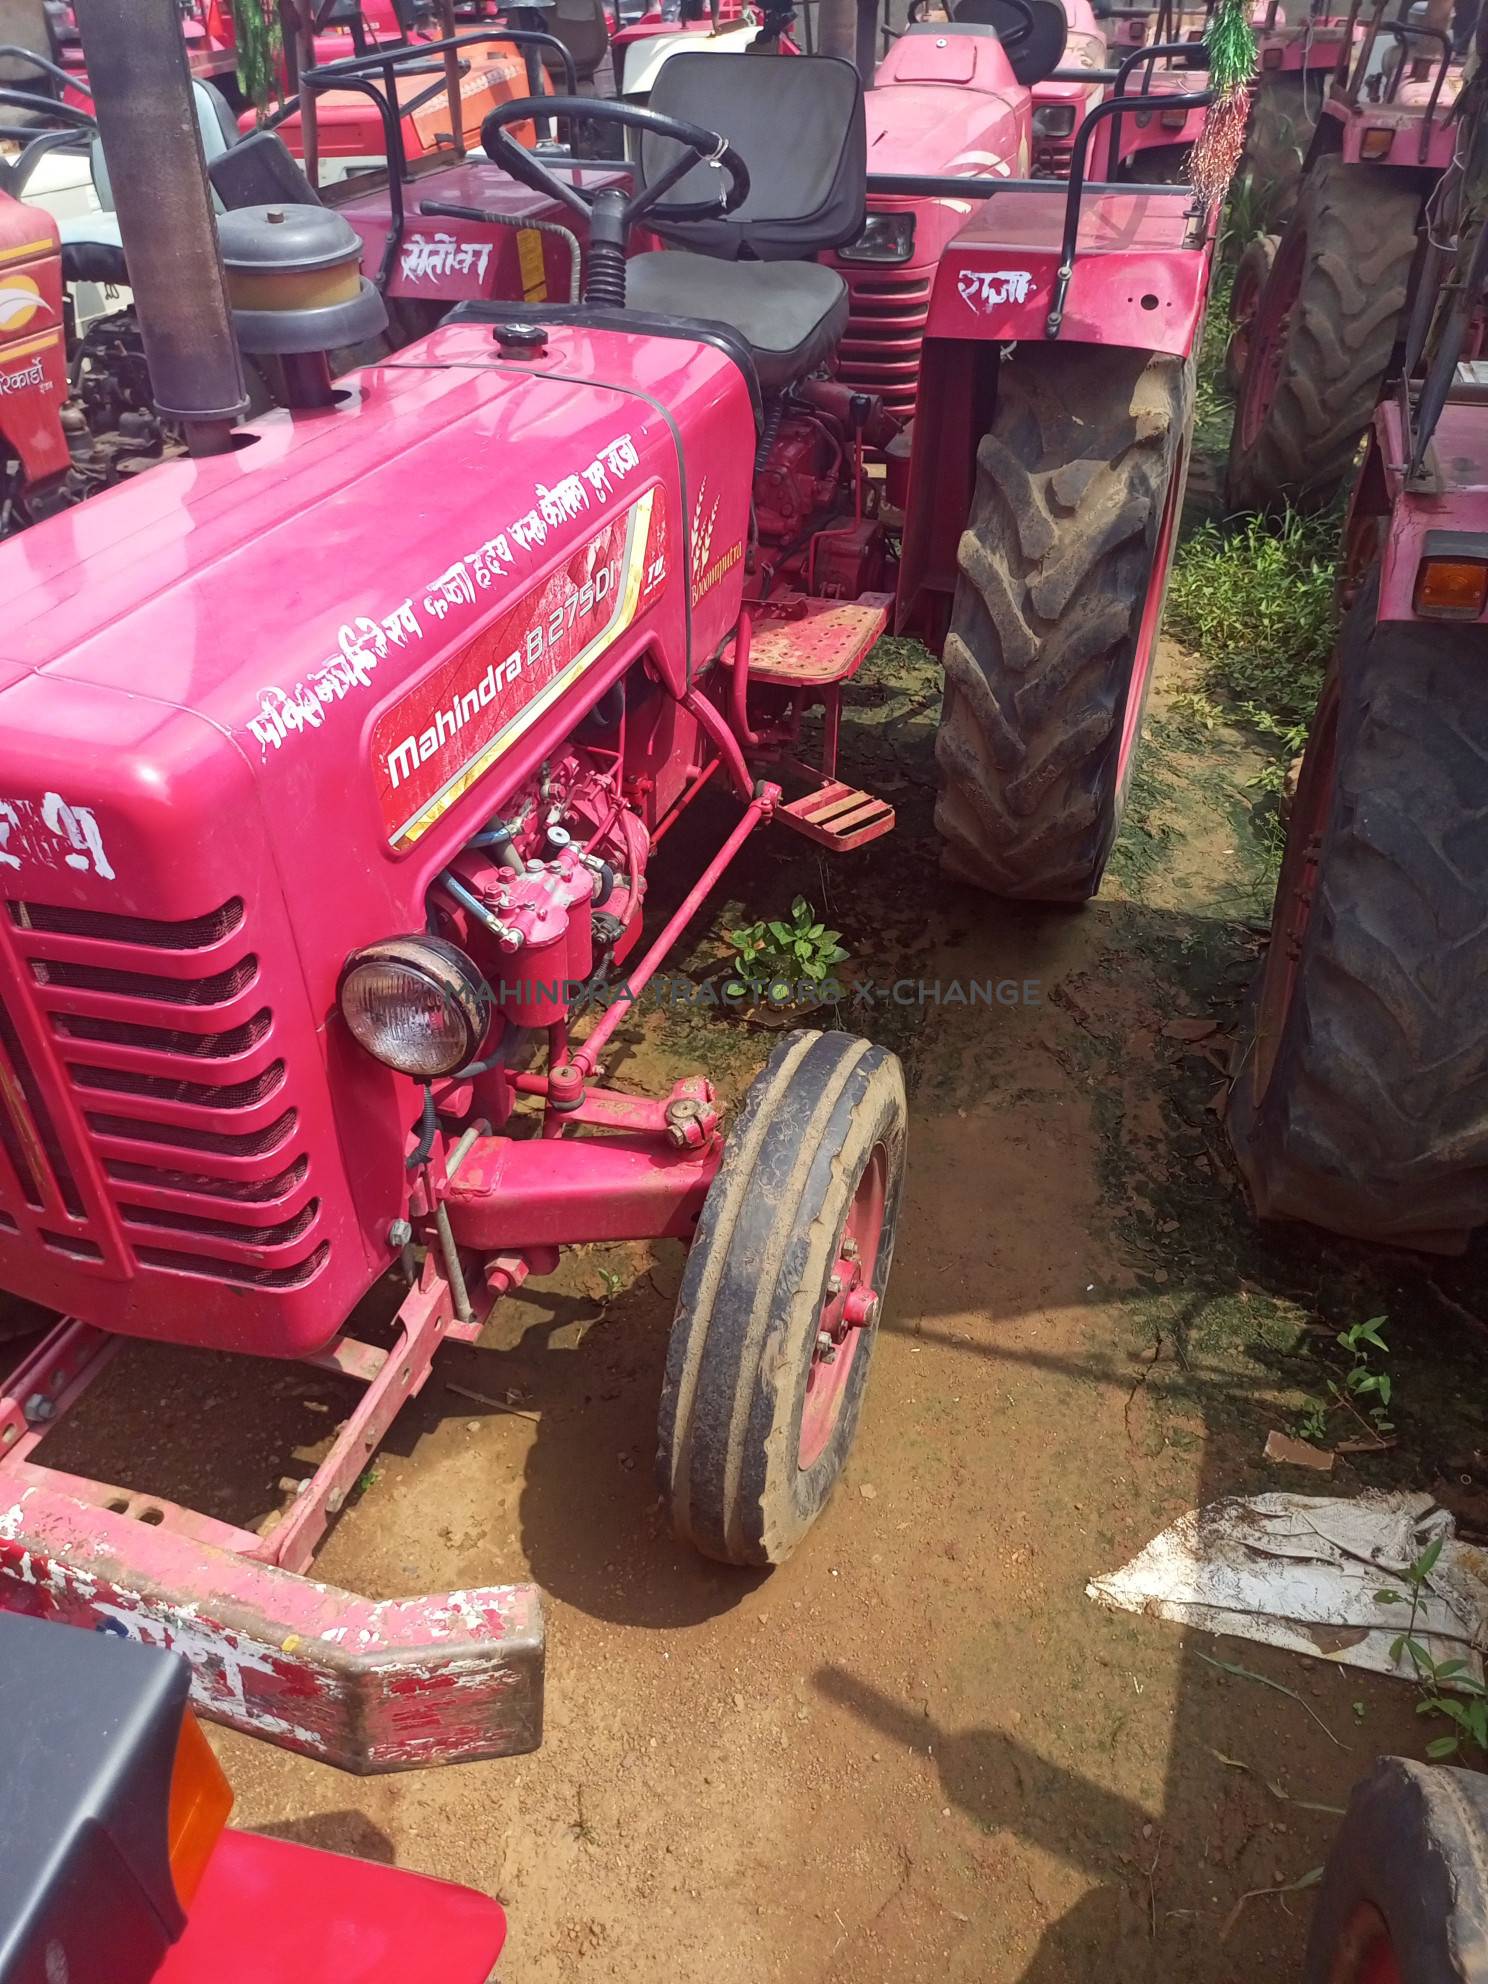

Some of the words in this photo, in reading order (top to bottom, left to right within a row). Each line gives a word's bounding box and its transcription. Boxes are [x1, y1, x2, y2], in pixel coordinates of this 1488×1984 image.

[957, 270, 1033, 316] राजा
[595, 433, 640, 480] राजा
[691, 540, 743, 608] Bhoomiputra
[387, 650, 522, 788] Mahindra
[527, 625, 543, 666] B
